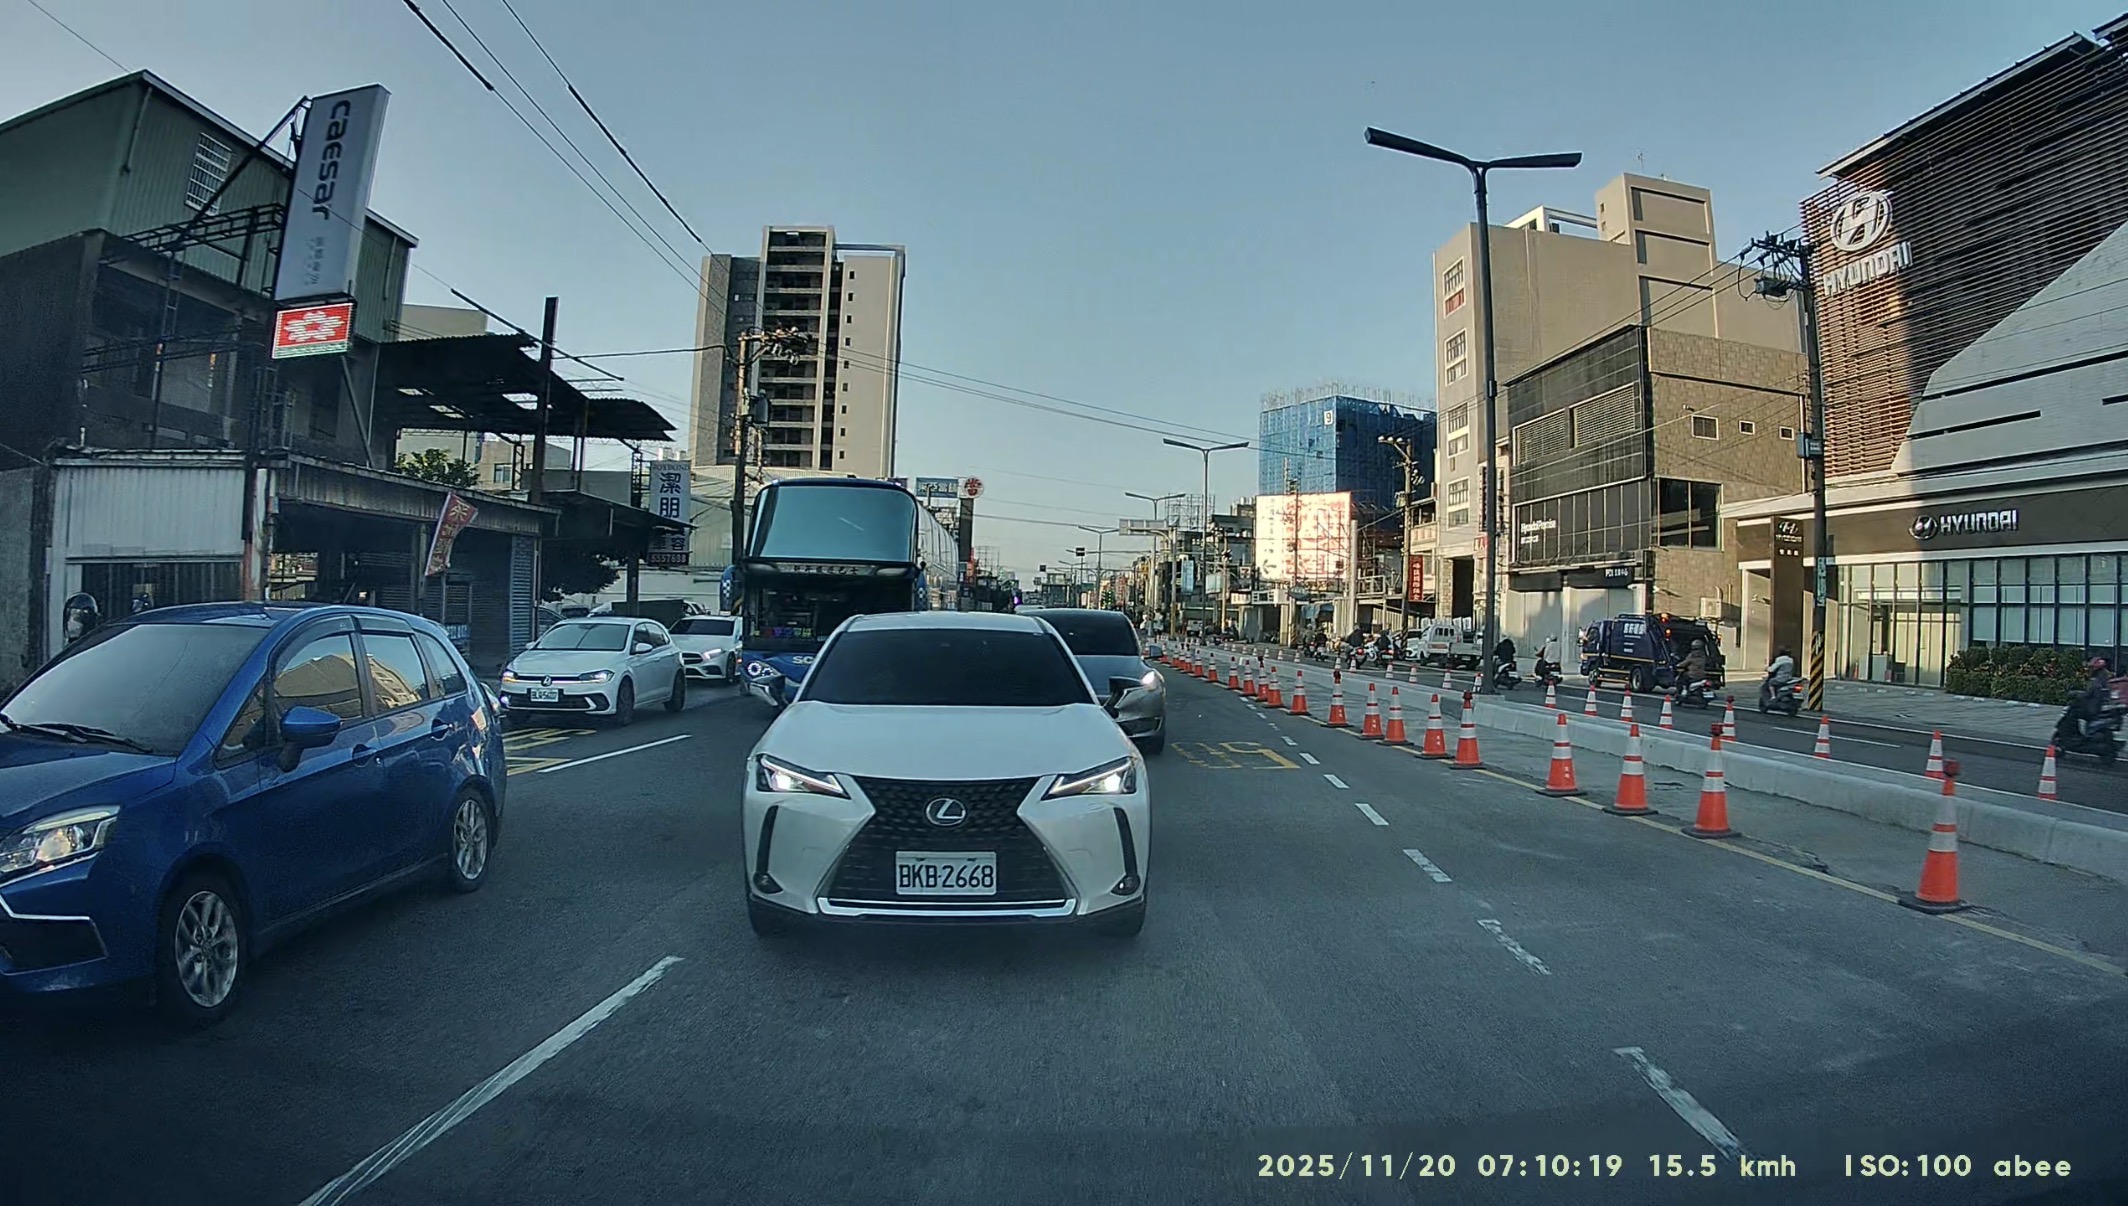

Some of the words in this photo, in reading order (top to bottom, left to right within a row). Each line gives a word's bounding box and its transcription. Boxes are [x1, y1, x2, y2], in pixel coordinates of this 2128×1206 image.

[313, 100, 351, 220] caesar
[1823, 241, 1913, 297] HYUNDAI
[1326, 412, 1332, 423] 9
[1940, 509, 2018, 534] HYUNDAI
[898, 864, 994, 888] BKB-2668
